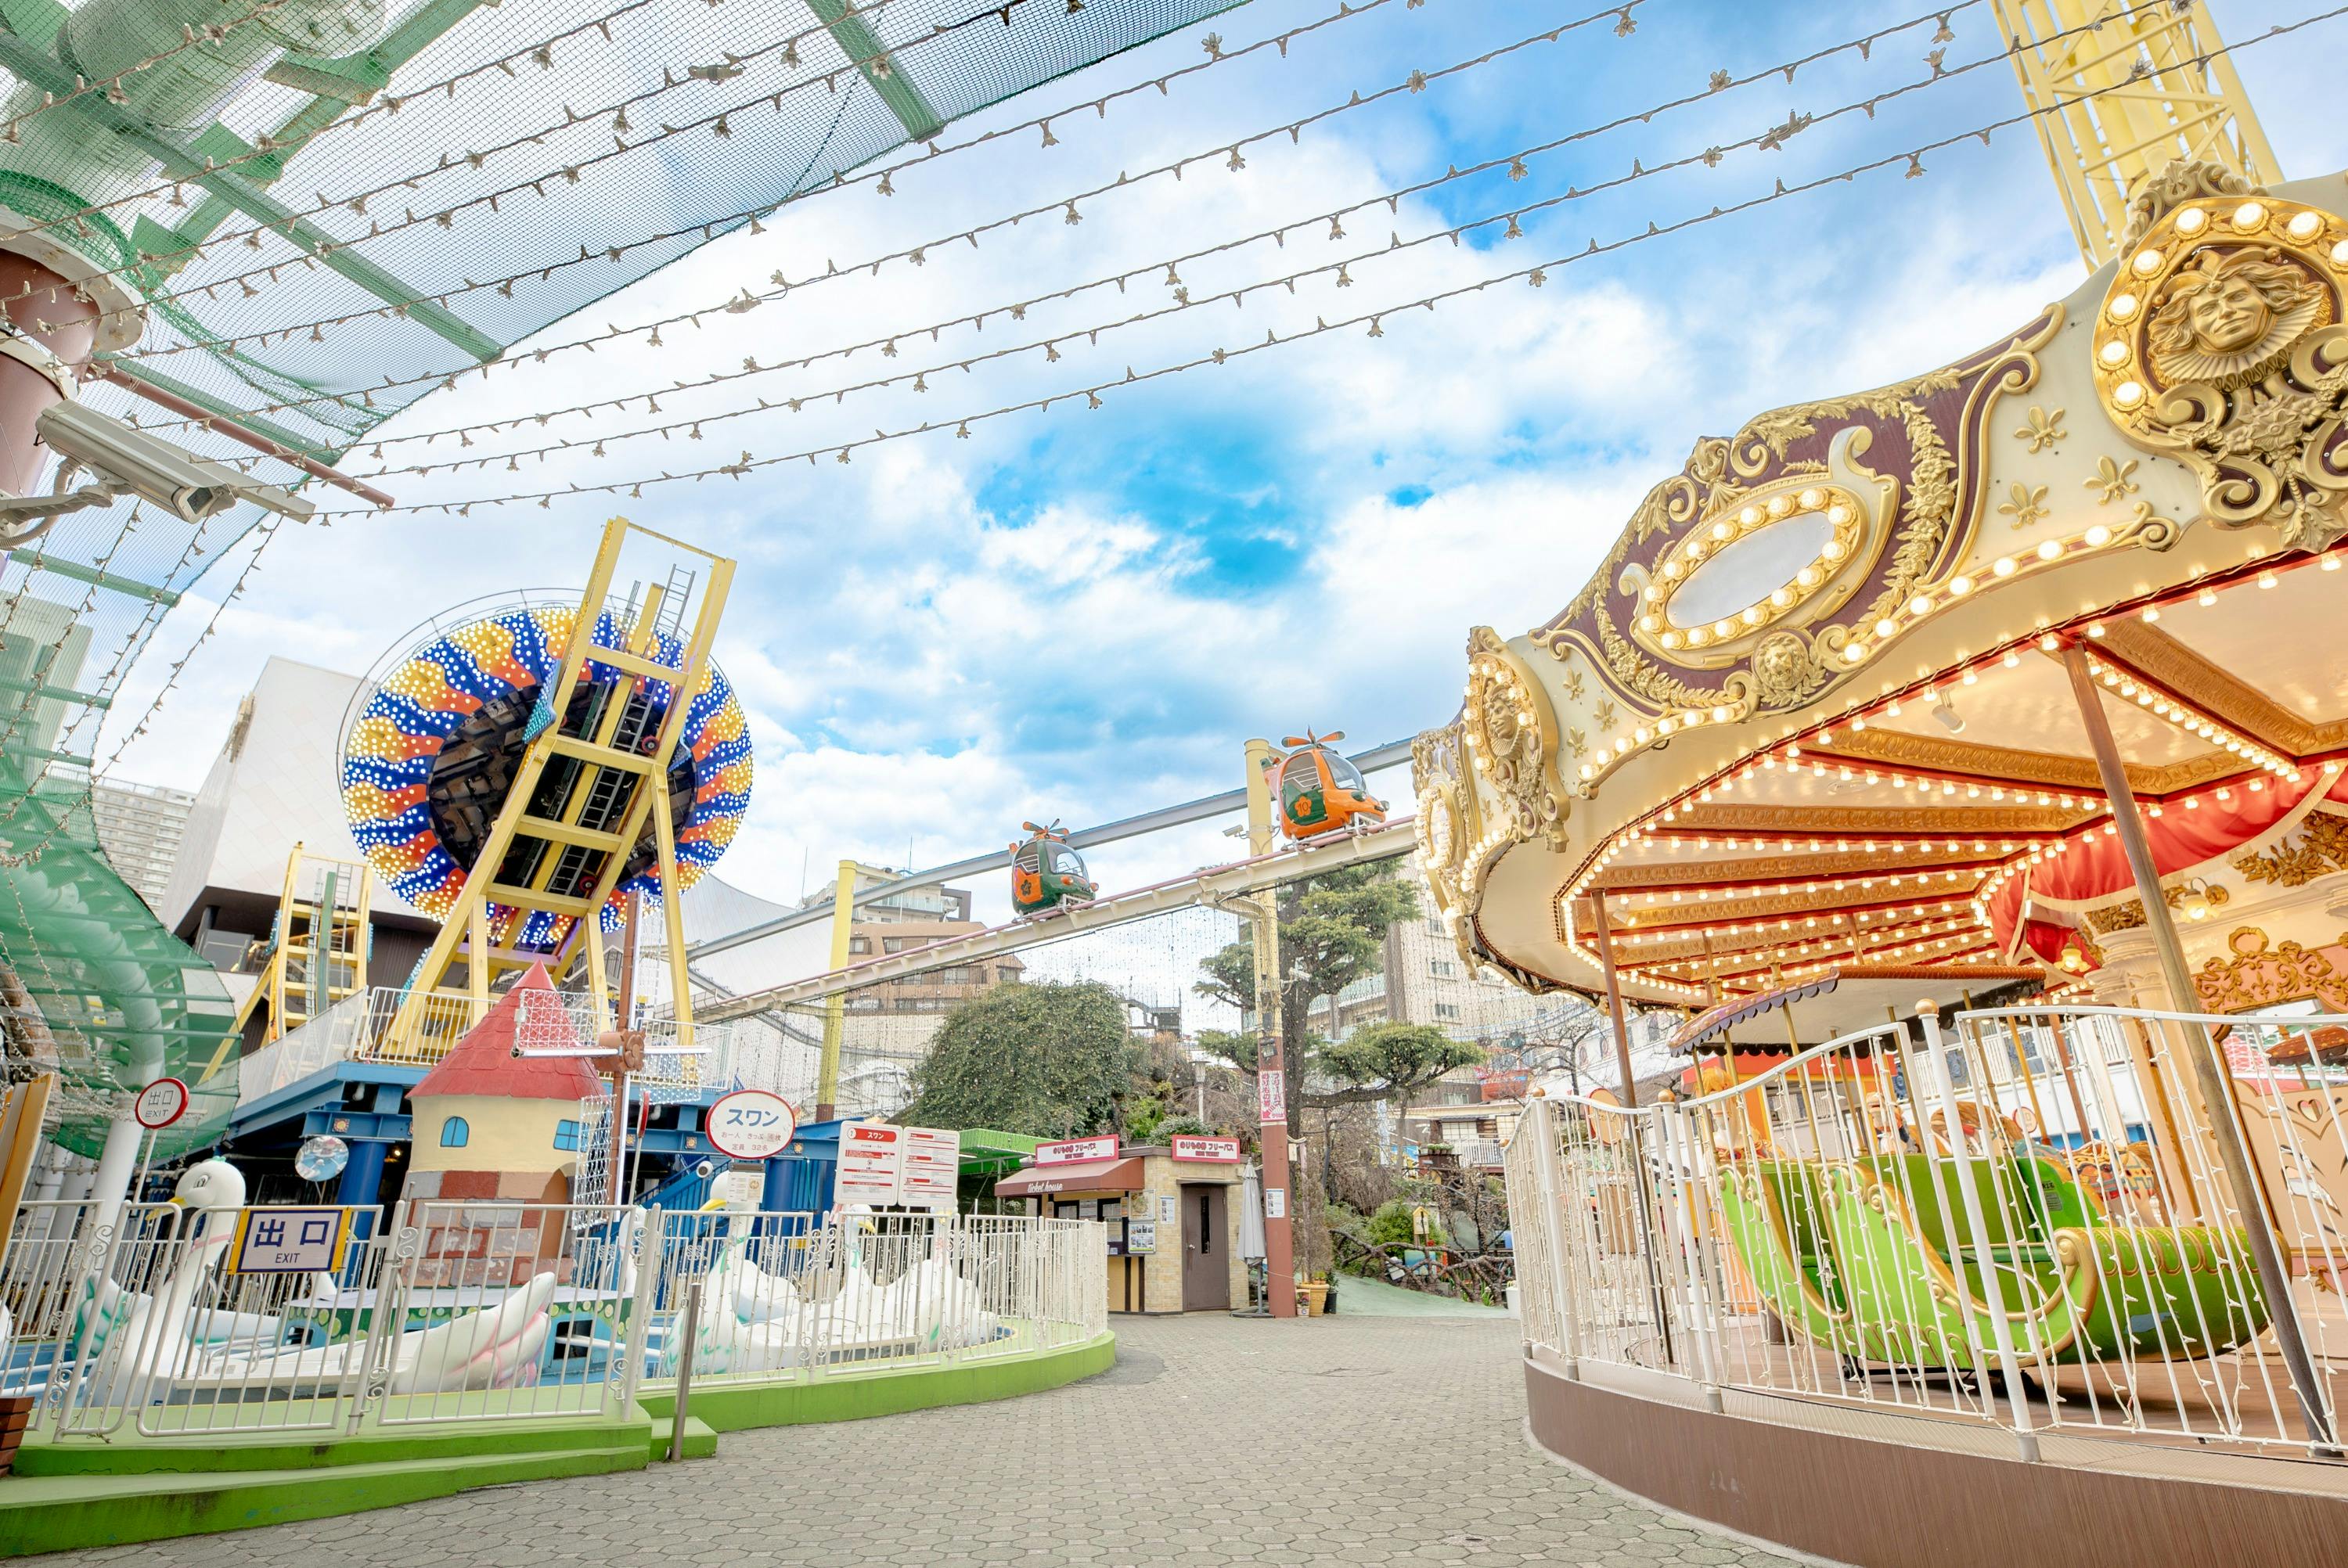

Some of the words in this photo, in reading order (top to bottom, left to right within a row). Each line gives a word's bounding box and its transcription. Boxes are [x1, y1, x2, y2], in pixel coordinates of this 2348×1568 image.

[1298, 802, 1308, 813] 10
[148, 1090, 174, 1106] 出口
[145, 1109, 169, 1117] EXIT
[726, 1109, 780, 1127] スワン
[867, 1131, 884, 1140] スワン
[1075, 1142, 1097, 1153] フリーパス
[1208, 1142, 1234, 1152] フリーパス
[1028, 1181, 1044, 1193] ticket
[1045, 1181, 1063, 1192] house
[254, 1218, 330, 1247] 出口
[275, 1253, 301, 1264] EXIT
